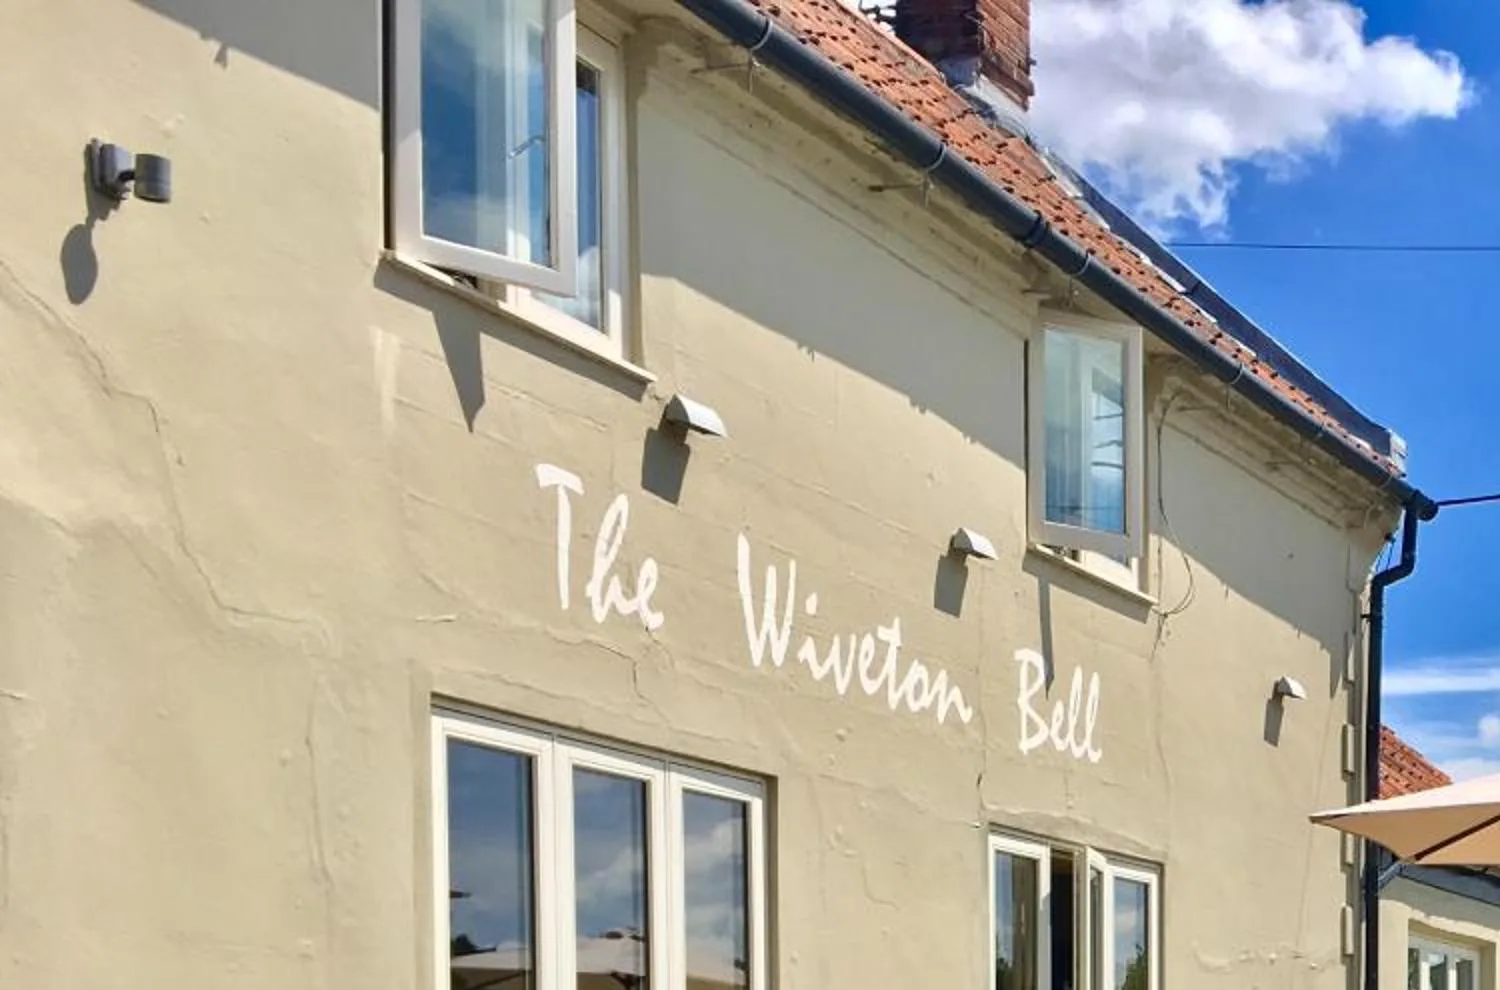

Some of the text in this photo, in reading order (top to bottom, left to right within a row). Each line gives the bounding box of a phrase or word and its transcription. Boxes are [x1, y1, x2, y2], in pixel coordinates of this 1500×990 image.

[536, 463, 1102, 763] The Wiveton Bell
